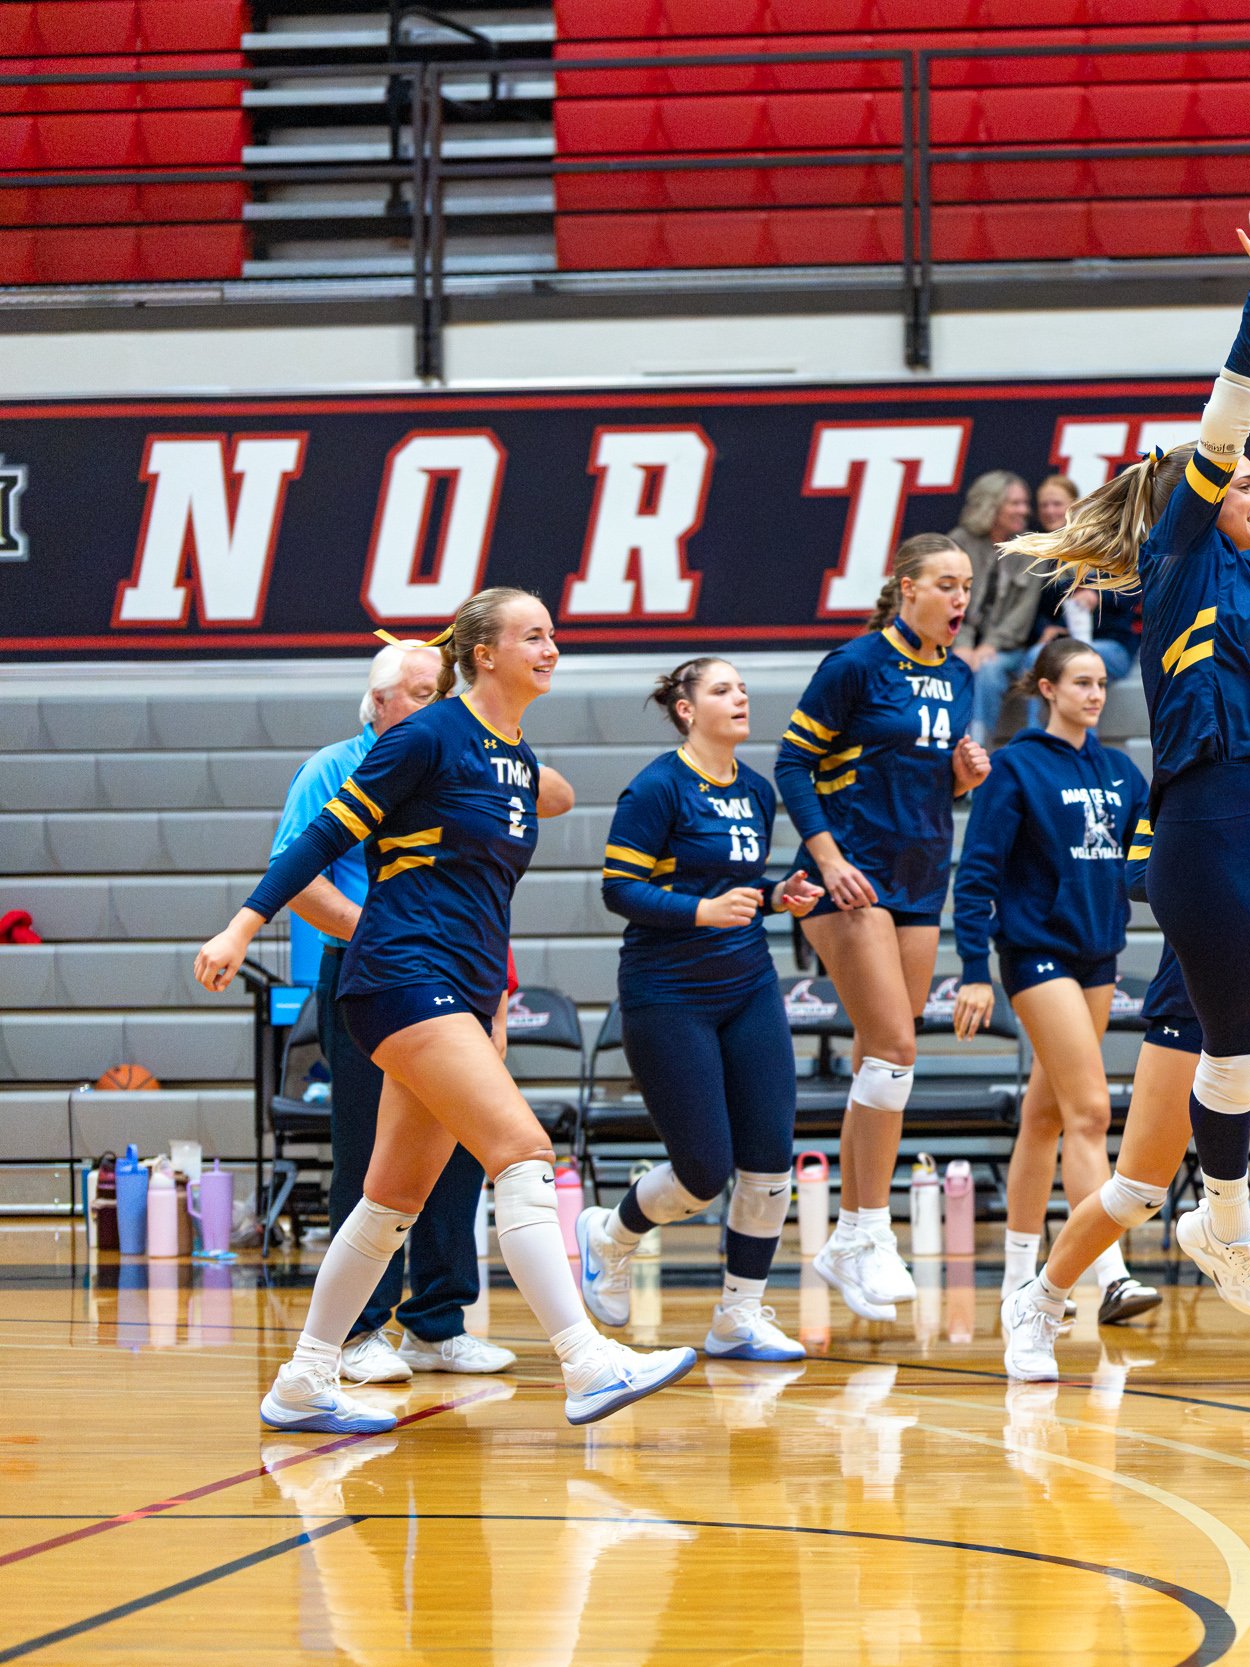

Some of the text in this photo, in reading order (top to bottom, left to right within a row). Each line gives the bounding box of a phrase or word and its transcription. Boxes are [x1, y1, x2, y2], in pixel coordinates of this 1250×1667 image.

[904, 675, 954, 702] TMU
[915, 704, 952, 750] 14
[728, 824, 761, 862] 13
